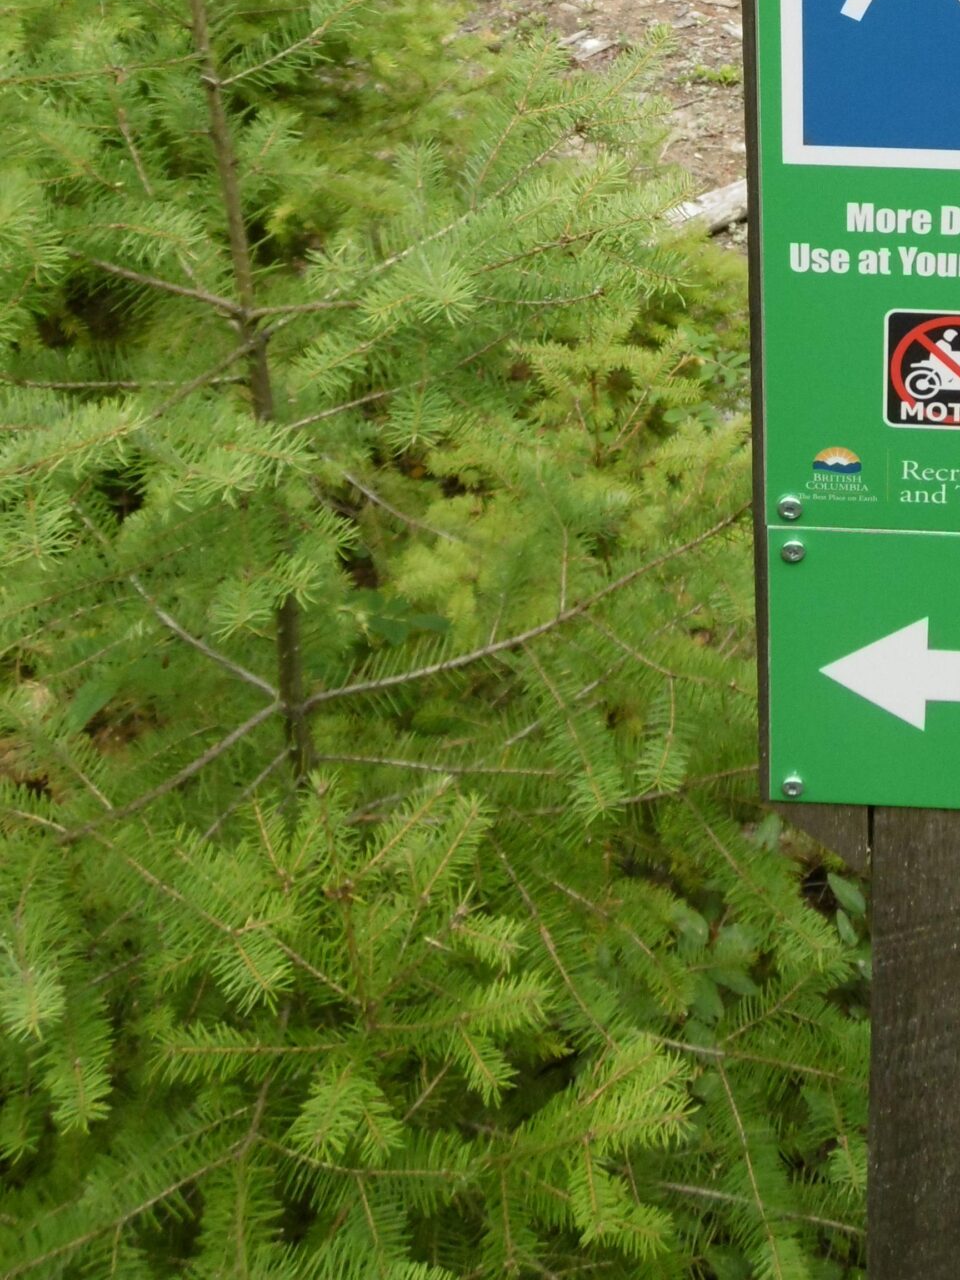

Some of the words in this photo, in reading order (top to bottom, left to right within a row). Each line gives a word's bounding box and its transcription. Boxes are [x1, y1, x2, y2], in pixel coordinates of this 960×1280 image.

[846, 202, 932, 234] More
[789, 242, 850, 273] Use
[858, 247, 891, 275] at
[805, 480, 869, 492] COLUMBIA
[813, 473, 862, 483] BRITISH
[899, 485, 948, 505] and
